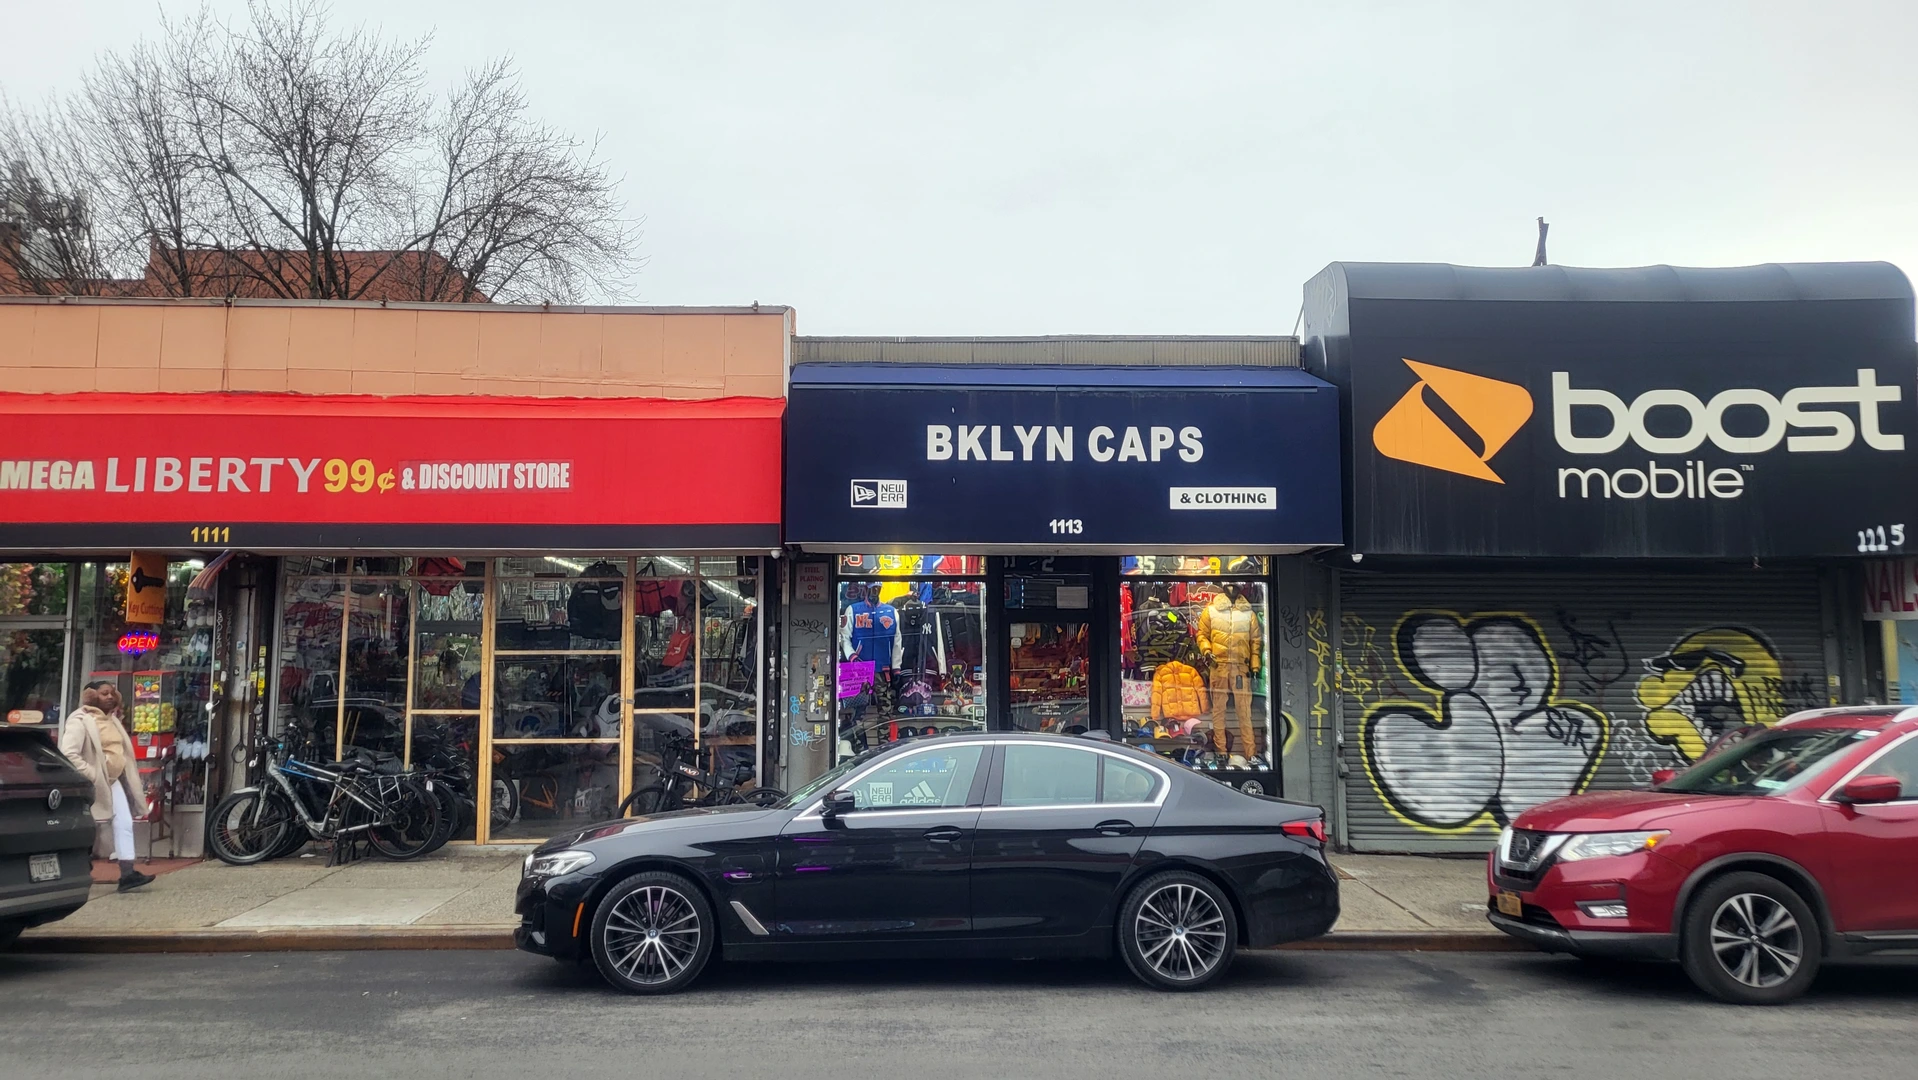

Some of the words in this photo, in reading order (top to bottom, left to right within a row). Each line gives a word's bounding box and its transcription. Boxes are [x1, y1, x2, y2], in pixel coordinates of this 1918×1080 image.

[1552, 368, 1906, 454] boost
[926, 424, 1073, 462] BKLYN
[1087, 425, 1205, 463] CAPS
[0, 460, 96, 490] MEGA
[104, 457, 322, 493] LIBERTY
[401, 467, 415, 490] &
[418, 462, 511, 490] DISCOUNT
[513, 462, 571, 489] STORE
[1558, 461, 1744, 500] mobile
[880, 483, 905, 493] NEW
[880, 493, 905, 503] ERA
[1179, 492, 1192, 504] &
[1194, 492, 1268, 505] CLOTHING
[1049, 519, 1083, 535] 1113
[190, 526, 230, 544] 1111
[1857, 523, 1906, 552] 1115
[799, 575, 825, 583] PLATING
[1863, 560, 1918, 613] NAIL
[803, 592, 820, 600] ROOF
[119, 636, 158, 649] OPEN
[871, 786, 892, 795] NEW
[871, 794, 892, 803] ERA
